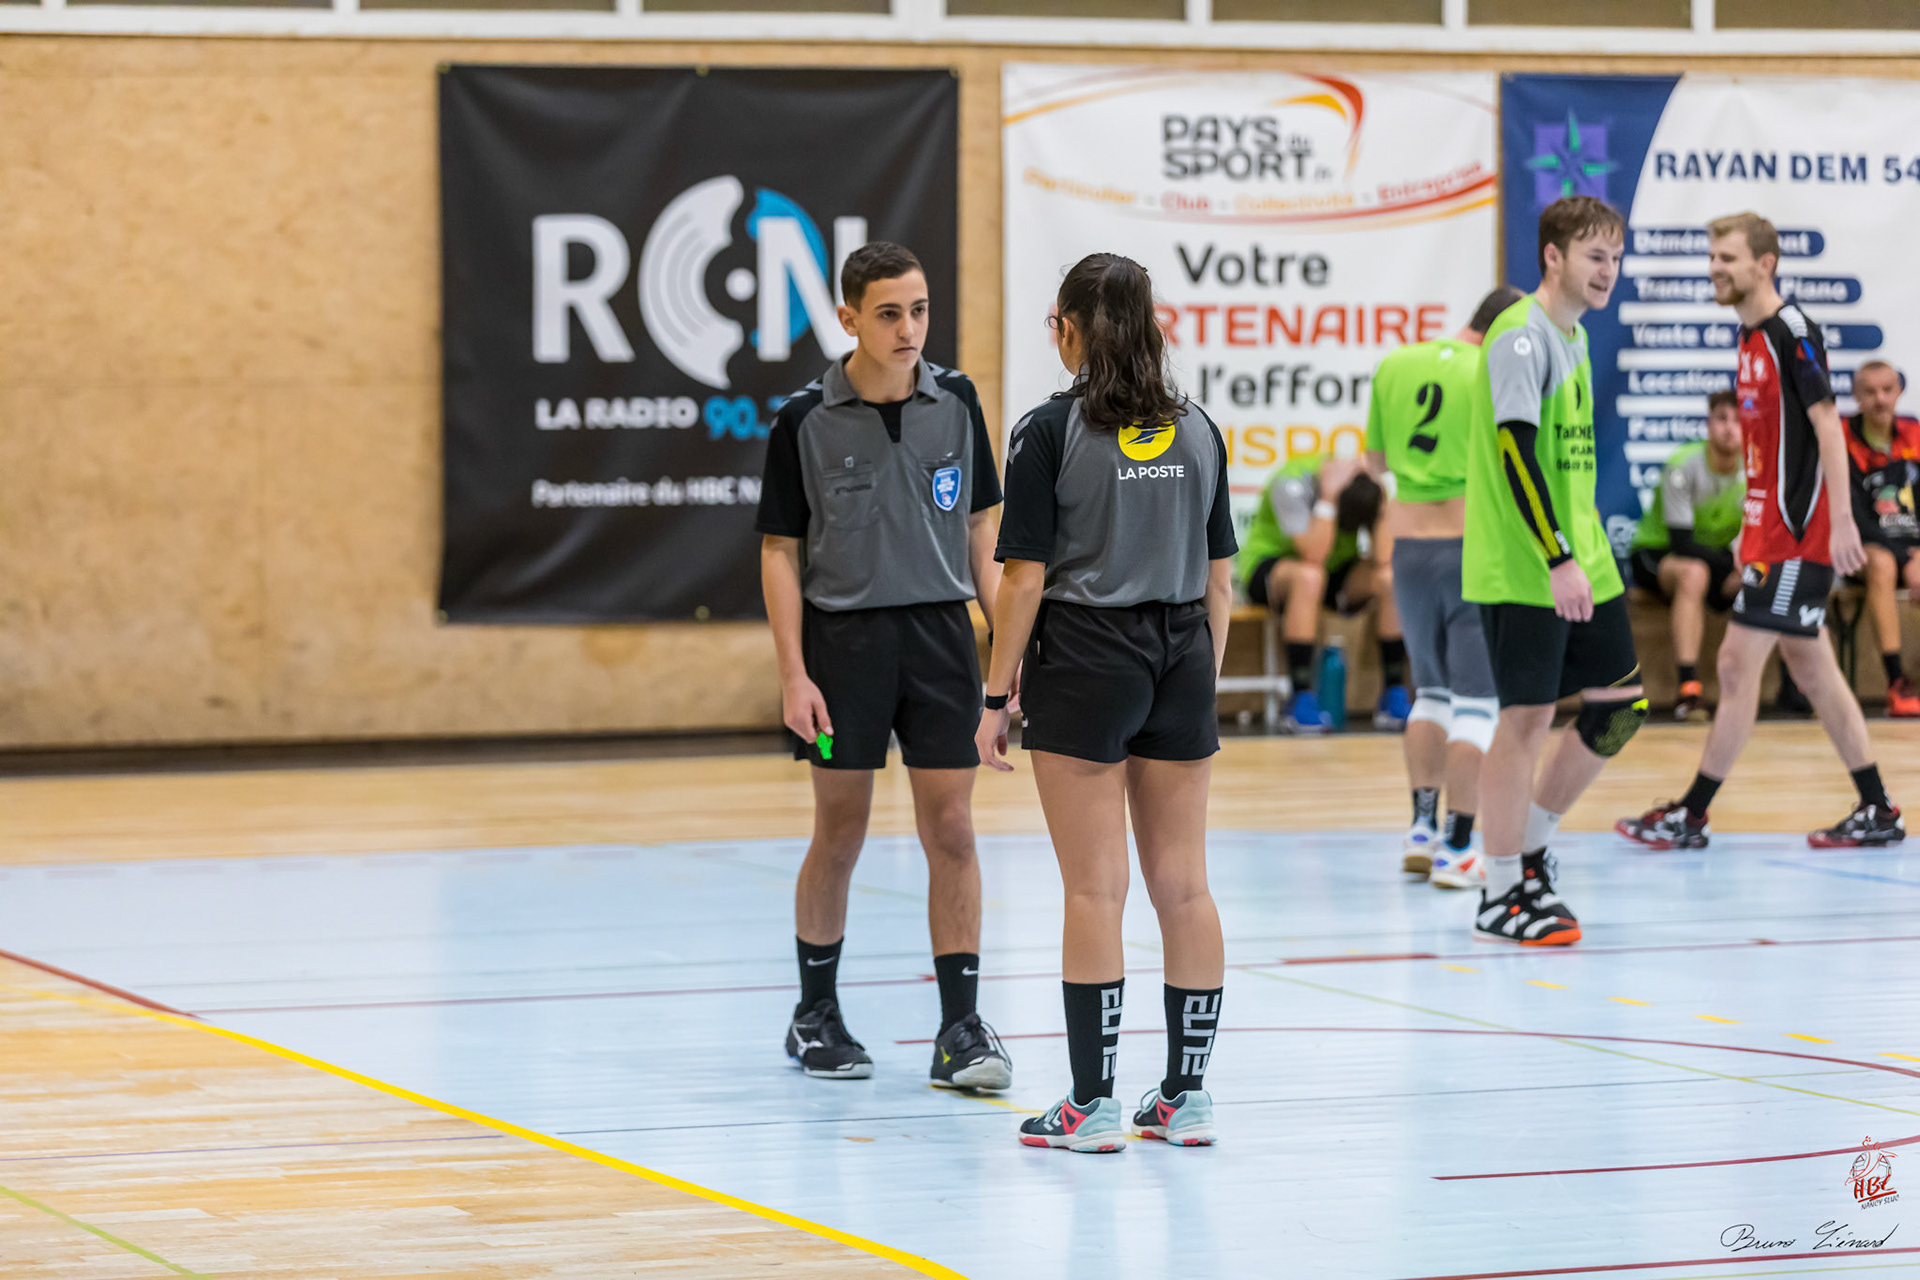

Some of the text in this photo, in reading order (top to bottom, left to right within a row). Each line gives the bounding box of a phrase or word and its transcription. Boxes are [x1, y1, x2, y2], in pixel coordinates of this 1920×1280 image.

[1162, 115, 1279, 145] PAYS
[1655, 152, 1920, 184] RAYAN DEM 54
[1023, 167, 1137, 205] Particulier
[1160, 191, 1212, 211] Club
[1377, 160, 1483, 203] Entreprise
[1176, 244, 1331, 288] Votre
[1634, 276, 1849, 304] Transp Piano
[1052, 304, 1448, 347] RTENAIRE
[1633, 325, 1733, 348] Vente de
[1199, 364, 1371, 408] l'effor
[1628, 370, 1731, 395] Location
[534, 398, 582, 430] LA
[584, 396, 699, 429] RADIO
[1408, 382, 1443, 454] 2
[1118, 465, 1185, 480] LA POSTE
[532, 478, 649, 508] Partenaire
